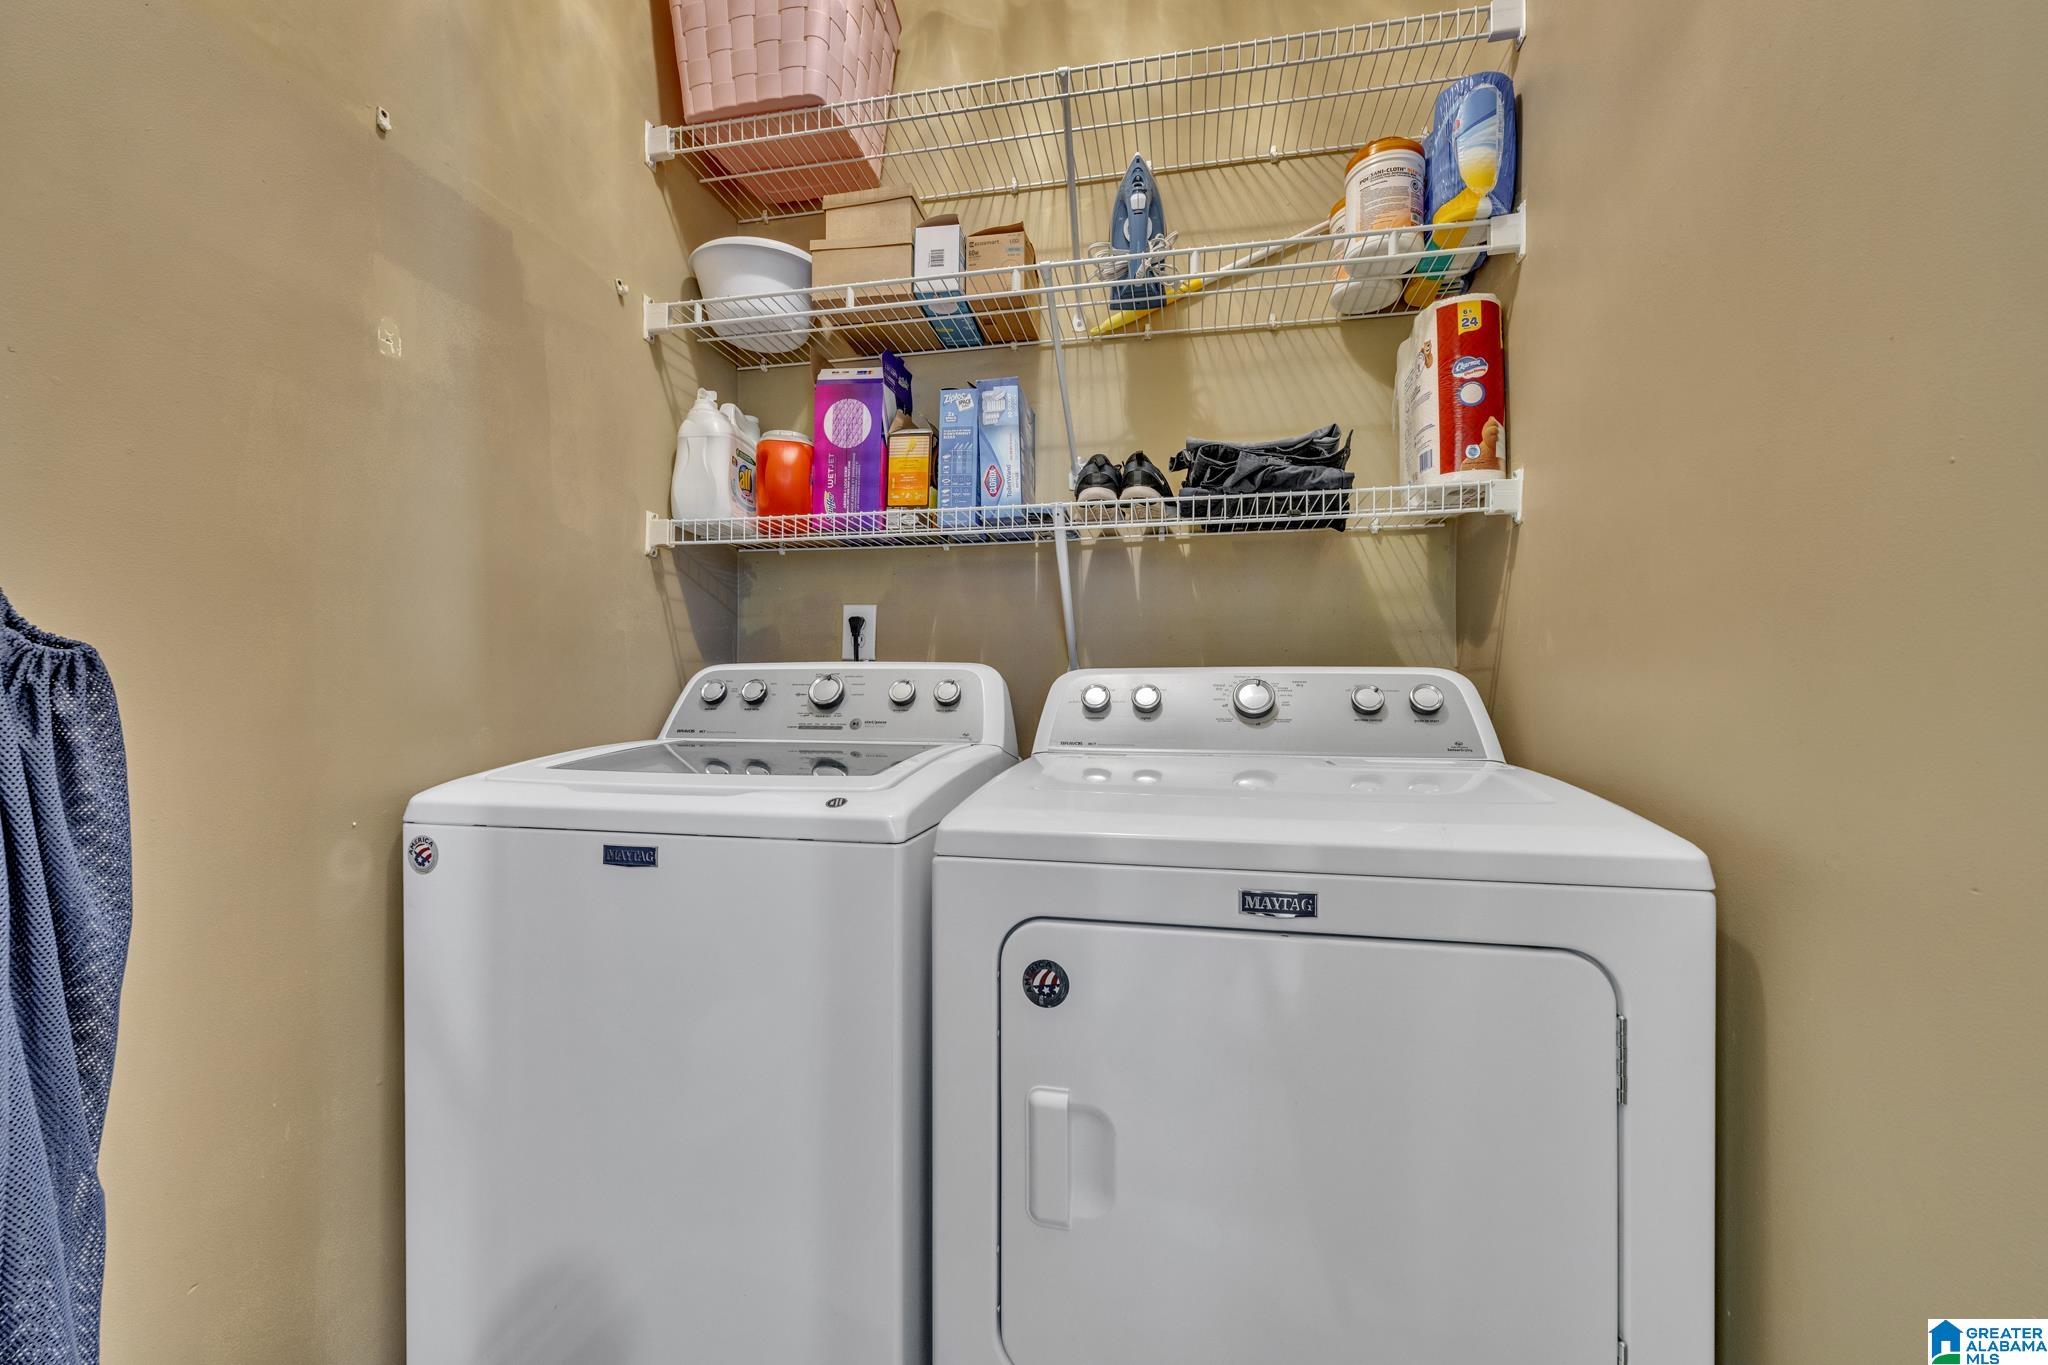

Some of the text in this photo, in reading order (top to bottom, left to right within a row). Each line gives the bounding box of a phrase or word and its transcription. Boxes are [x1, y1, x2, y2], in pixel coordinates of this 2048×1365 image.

[1462, 316, 1478, 327] 24
[740, 469, 751, 490] all
[989, 468, 997, 494] CLOROX
[409, 837, 433, 855] AMERICA
[607, 849, 654, 862] MAYTAG
[1244, 895, 1313, 911] MAYTAG
